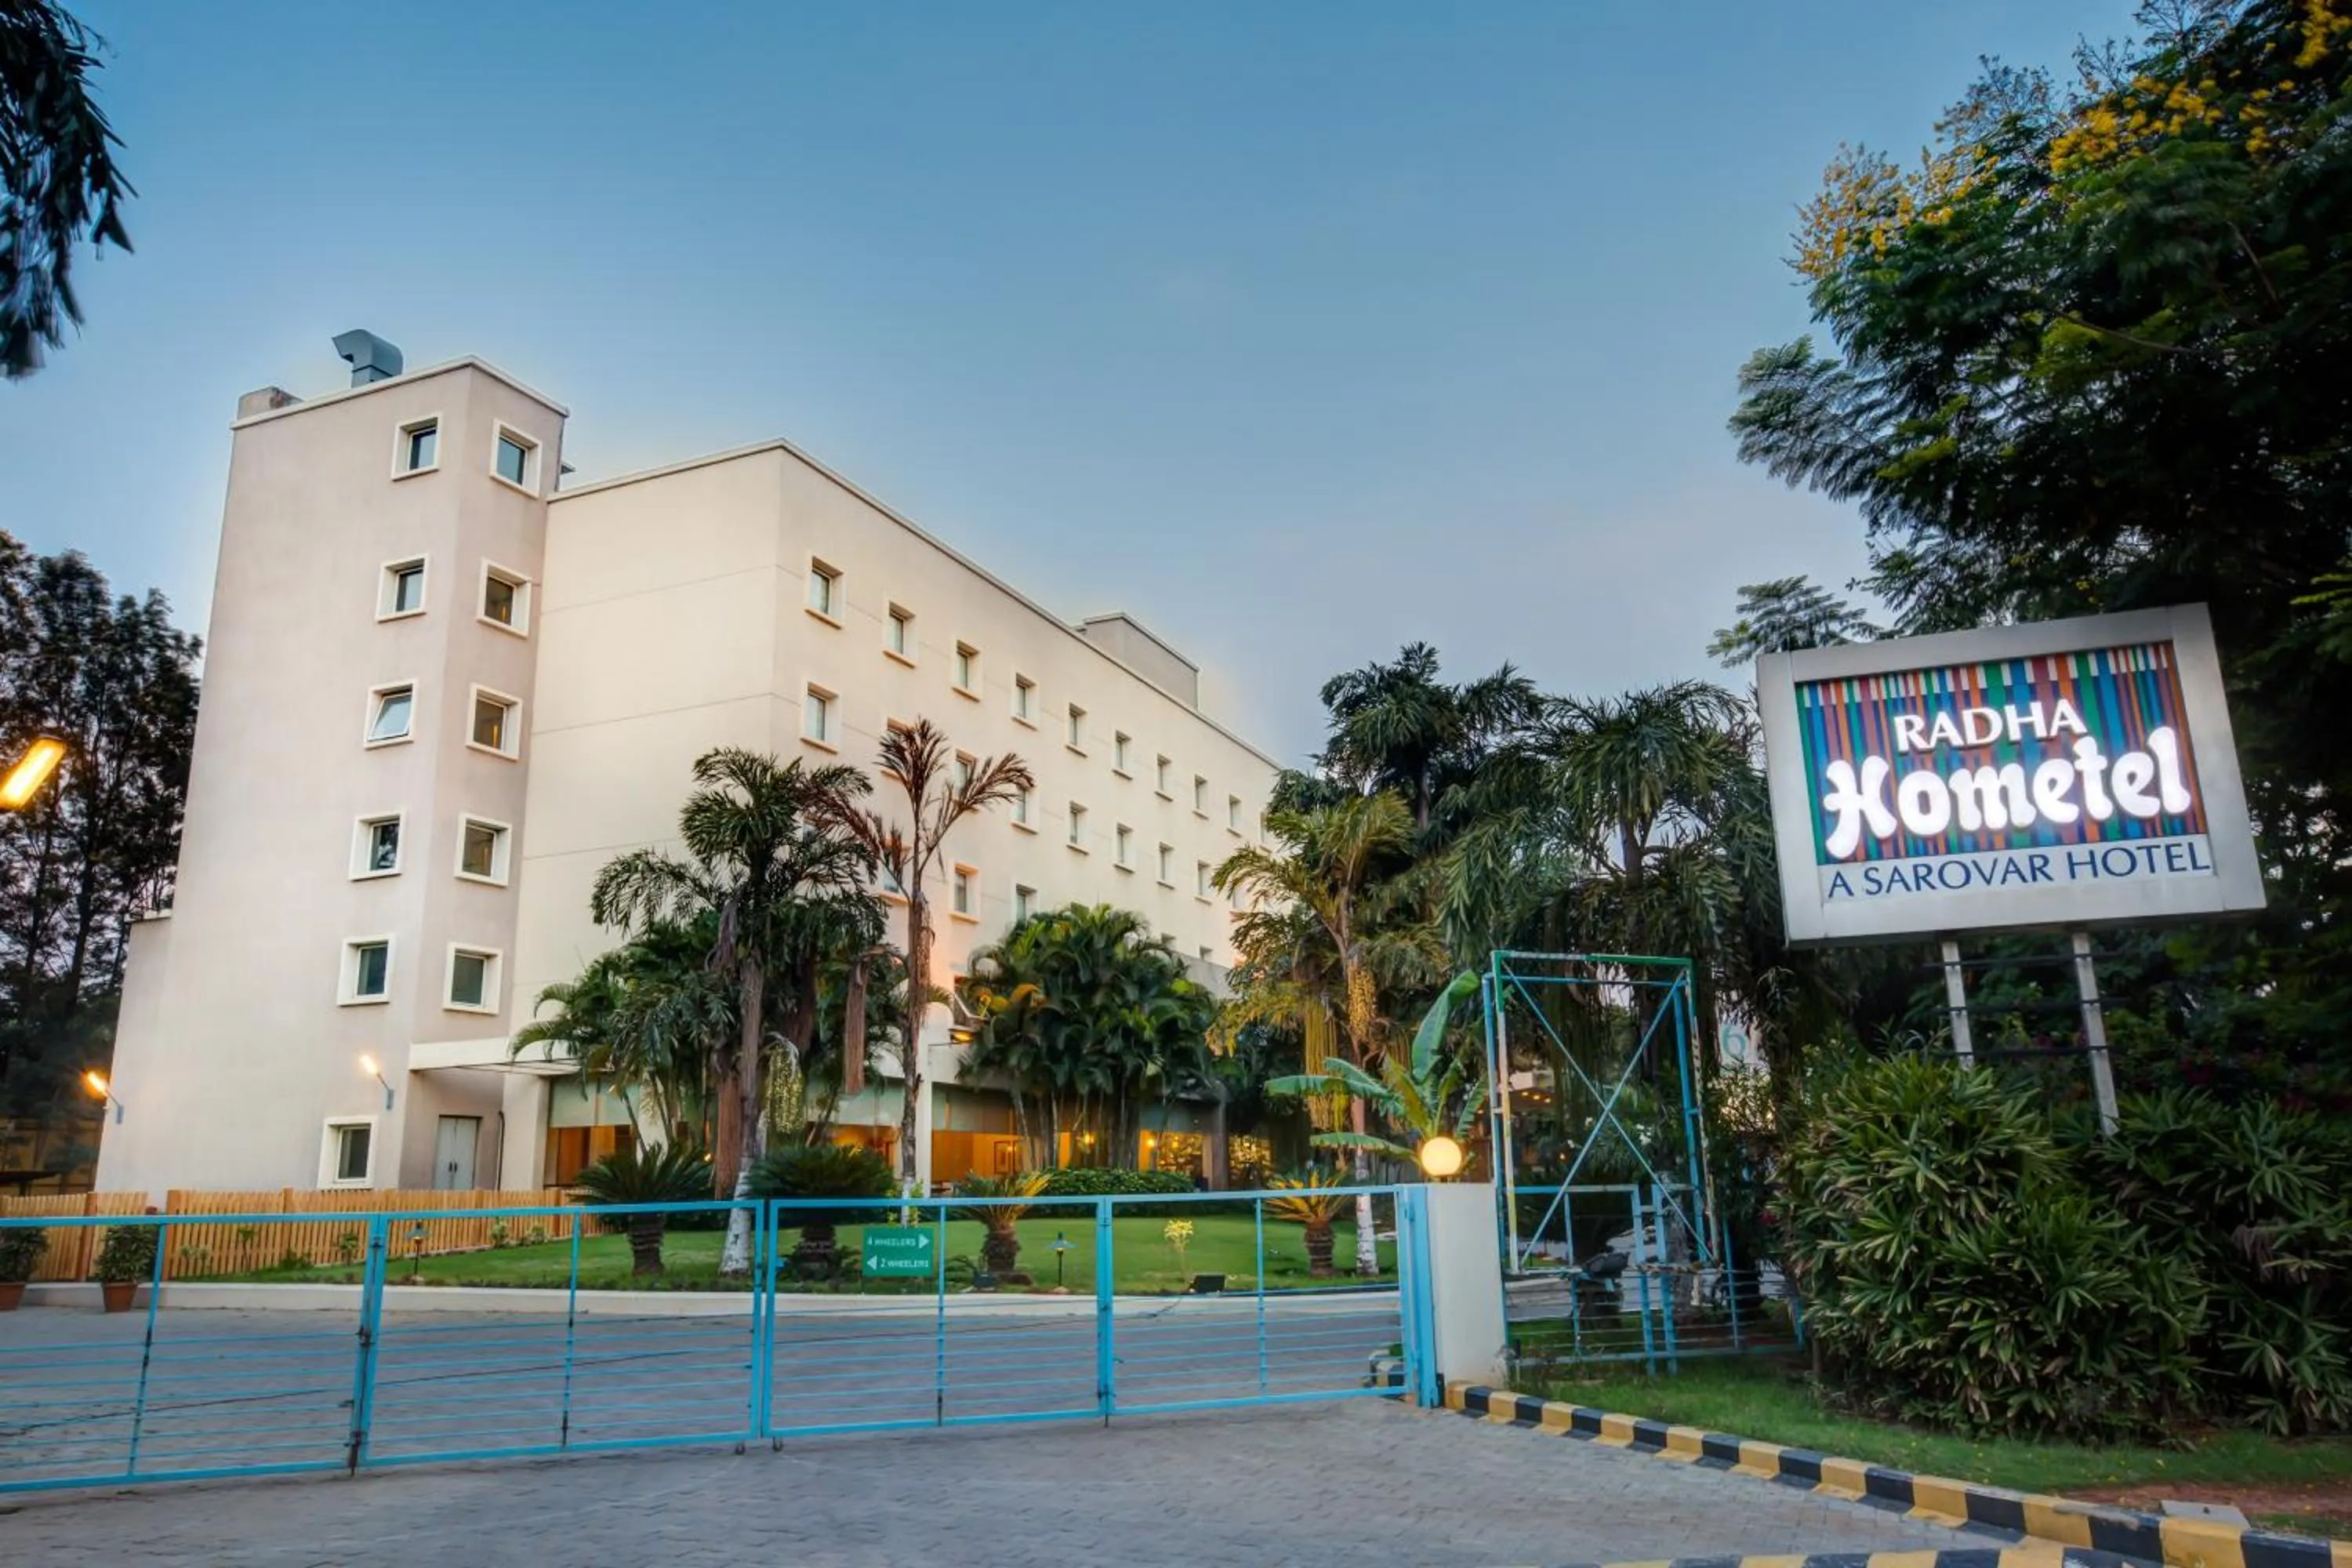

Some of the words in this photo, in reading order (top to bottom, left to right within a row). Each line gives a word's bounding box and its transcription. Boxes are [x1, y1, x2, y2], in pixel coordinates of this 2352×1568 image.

[1894, 699, 2087, 753] RADHA
[1823, 726, 2191, 859] Hometel
[1828, 871, 1855, 899] A
[1864, 858, 2053, 896] SAROVAR
[2067, 843, 2212, 880] HOTEL
[874, 1238, 916, 1247] WHEELERS
[880, 1258, 886, 1267] 2
